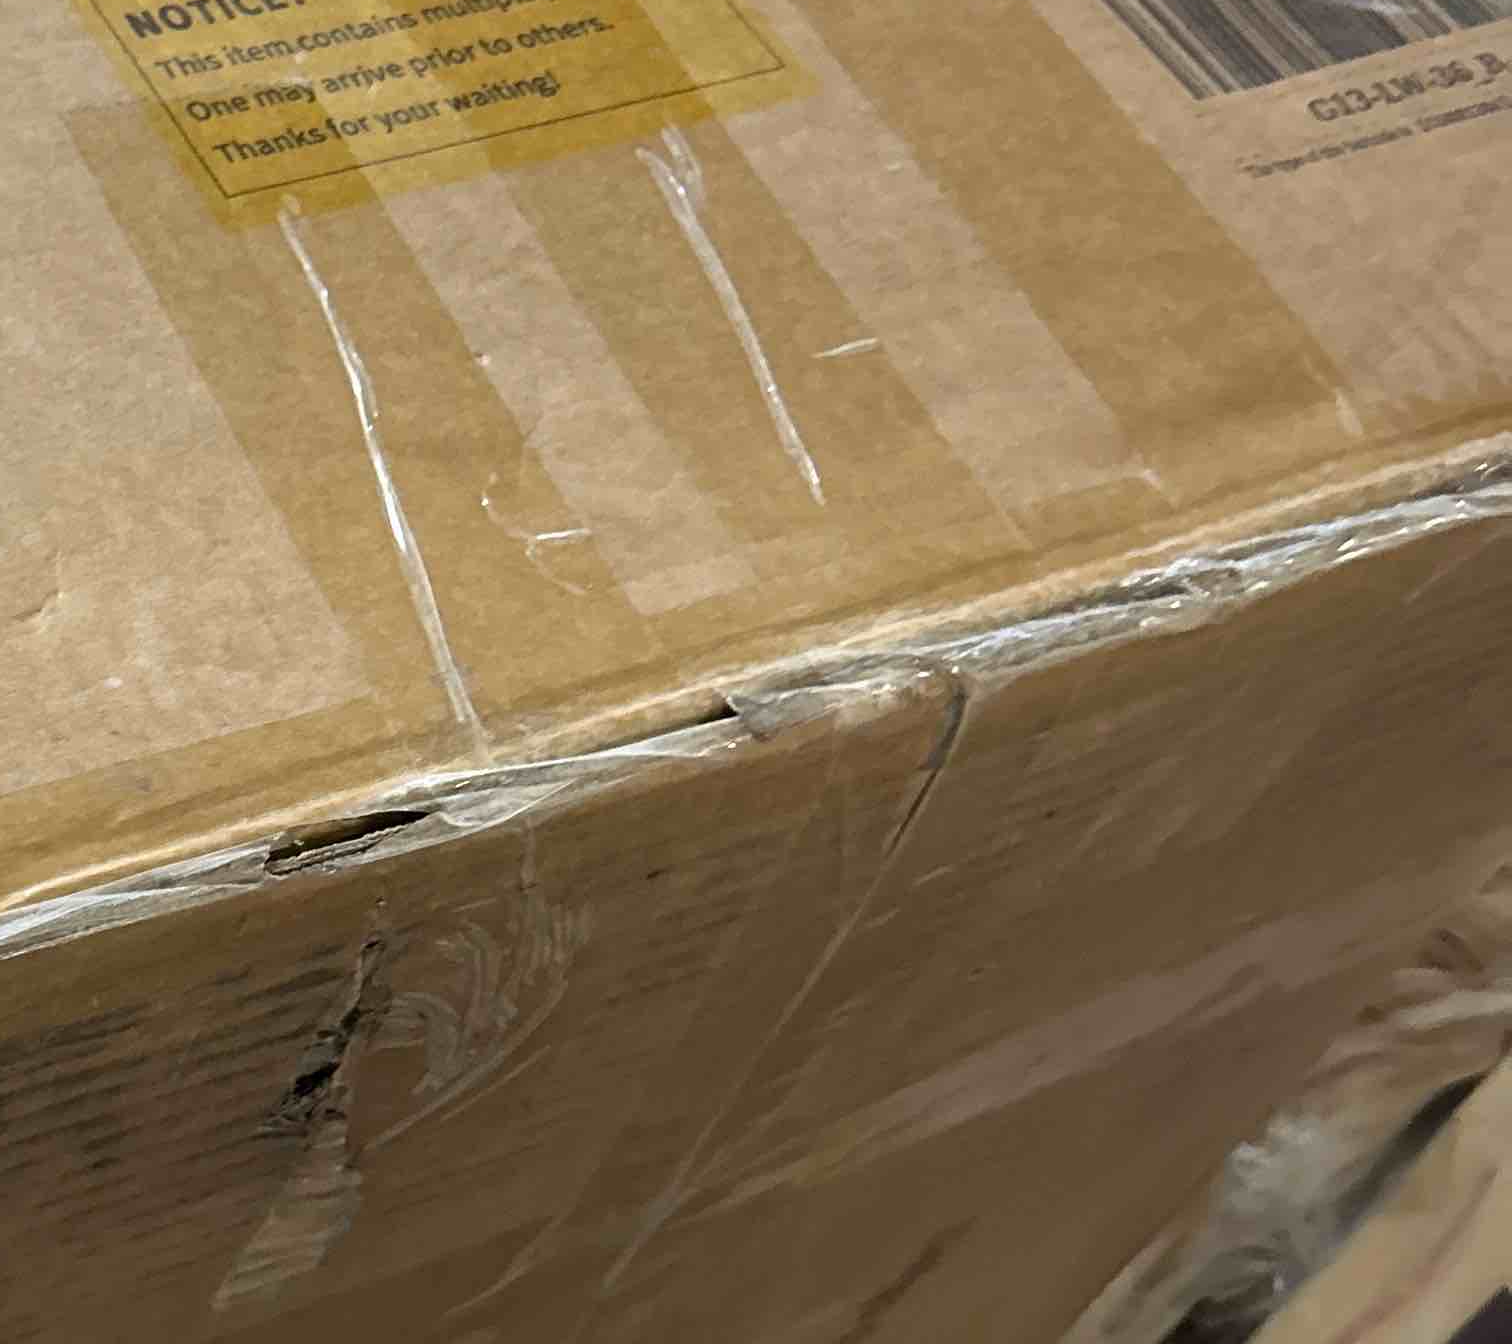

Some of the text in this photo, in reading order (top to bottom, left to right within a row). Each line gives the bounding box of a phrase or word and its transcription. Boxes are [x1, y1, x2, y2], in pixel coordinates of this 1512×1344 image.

[154, 52, 224, 82] This
[295, 10, 419, 54] contains
[184, 14, 616, 124] One may arrive prior to others.
[211, 70, 562, 164] Thanks for your waiting!
